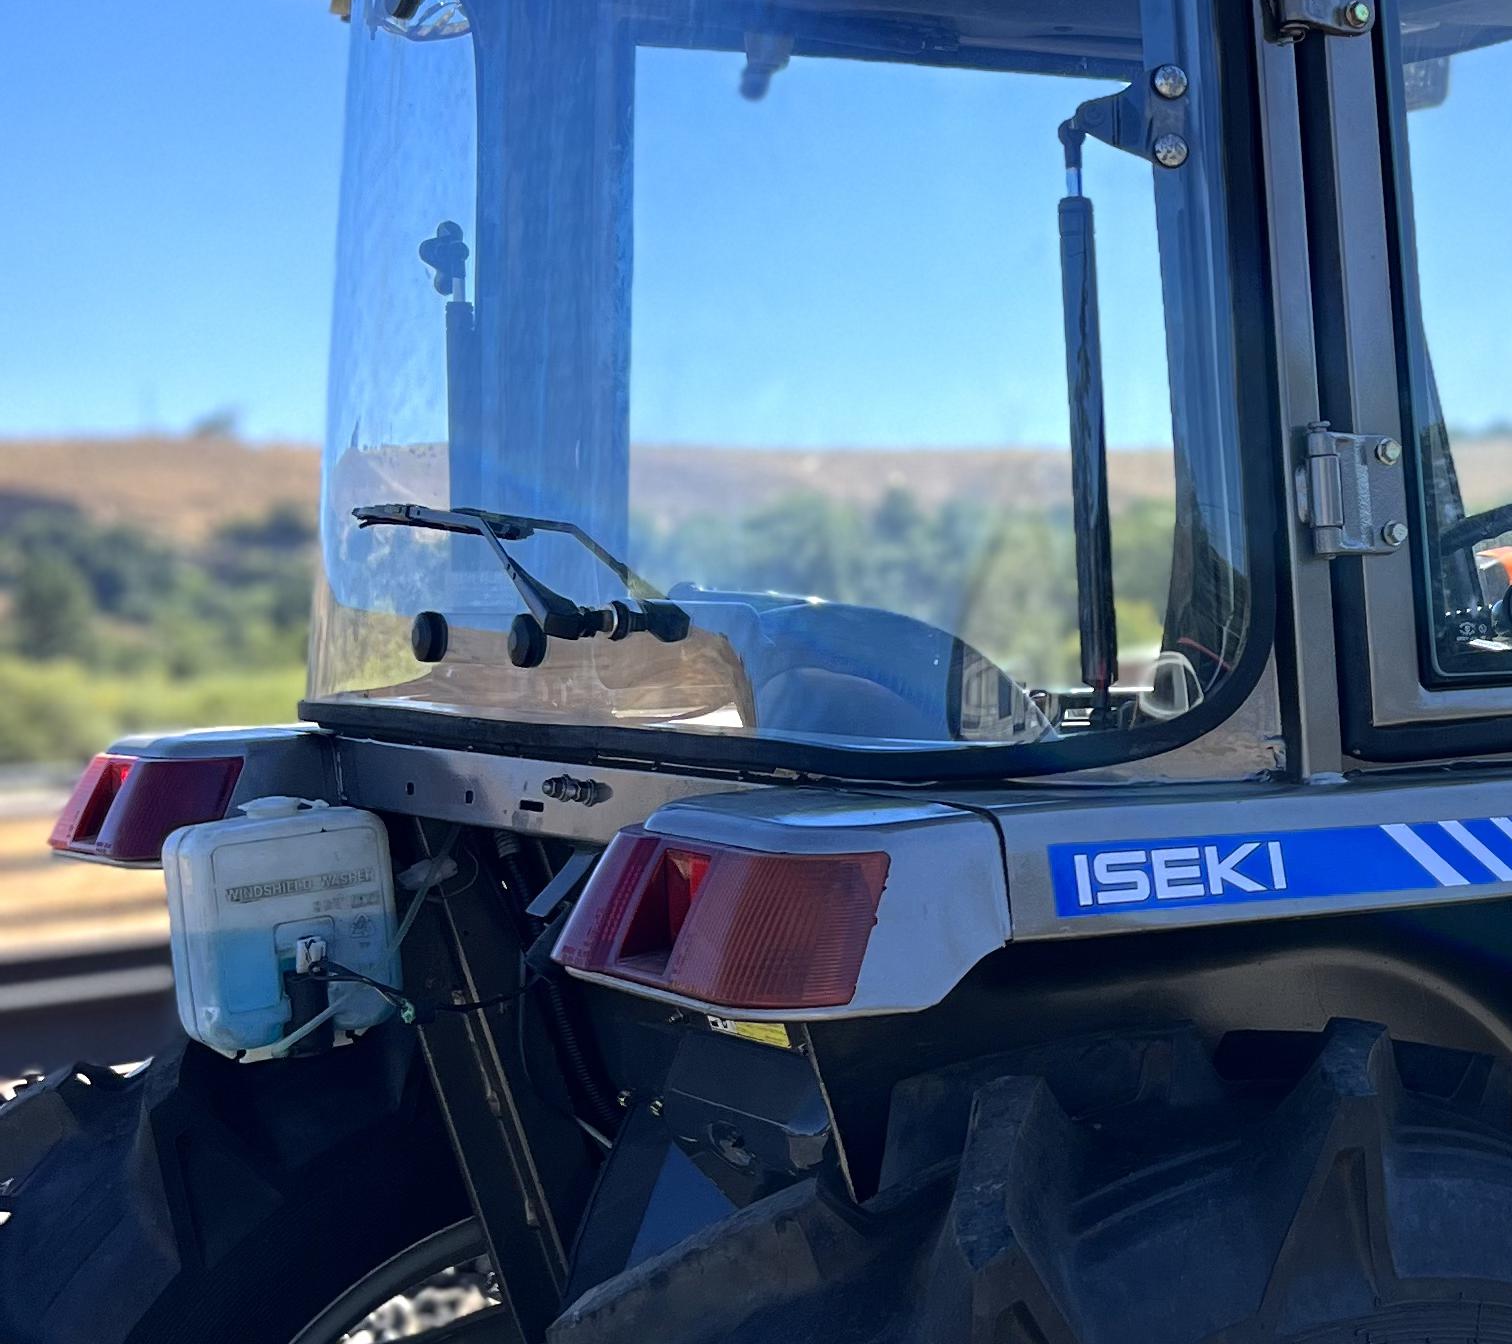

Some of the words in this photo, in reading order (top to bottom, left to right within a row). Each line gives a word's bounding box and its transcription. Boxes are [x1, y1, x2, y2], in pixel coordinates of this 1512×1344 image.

[225, 878, 313, 902] WINDSHIELD
[320, 867, 375, 889] WASHER
[1073, 840, 1288, 906] ISEKI
